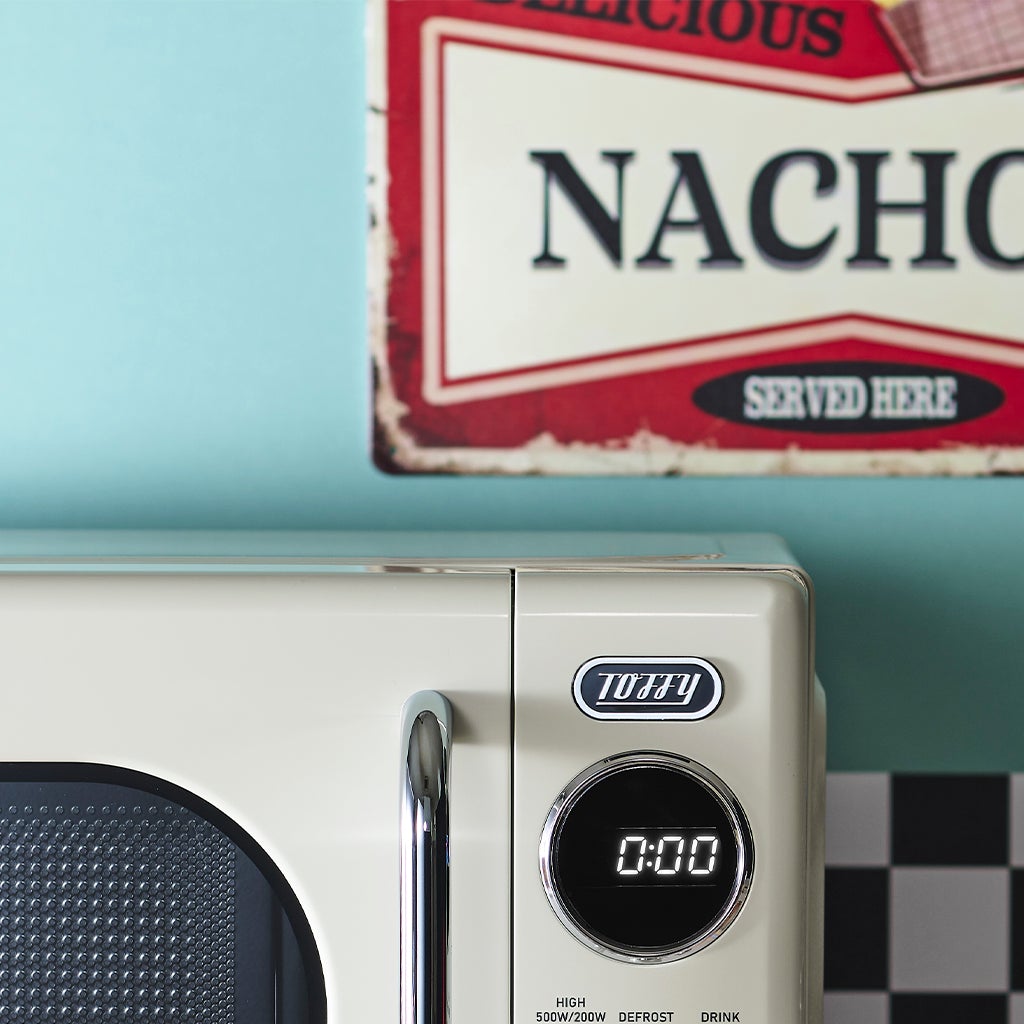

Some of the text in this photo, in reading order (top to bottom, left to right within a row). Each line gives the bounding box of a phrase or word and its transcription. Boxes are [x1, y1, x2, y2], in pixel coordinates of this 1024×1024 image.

[528, 149, 1024, 271] NACHO
[743, 375, 958, 420] SERVED HERE
[615, 835, 720, 876] 0:00
[556, 996, 586, 1008] HIGH
[536, 1011, 607, 1023] 500W/200W
[618, 1011, 675, 1023] DEFROST
[701, 1011, 741, 1023] DRINK
